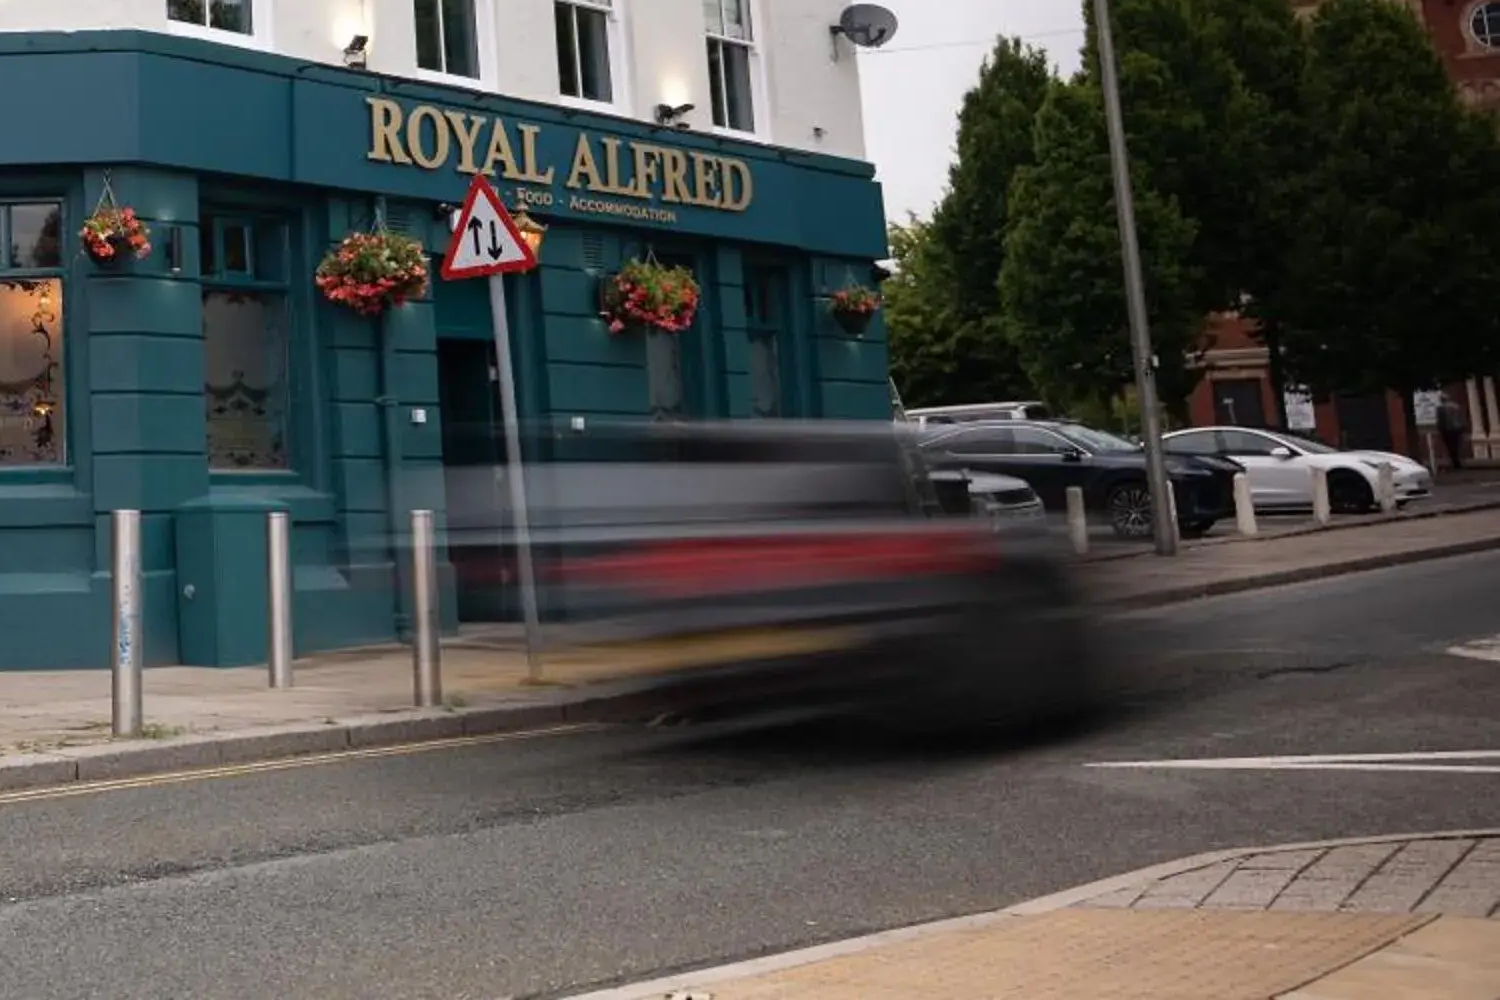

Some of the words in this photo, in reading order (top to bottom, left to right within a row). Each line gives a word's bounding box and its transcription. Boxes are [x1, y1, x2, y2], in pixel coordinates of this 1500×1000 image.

[366, 98, 554, 184] ROYAL
[567, 133, 752, 211] ALFRED
[516, 187, 553, 206] FOOD
[569, 195, 676, 222] ACCOMMODATION
